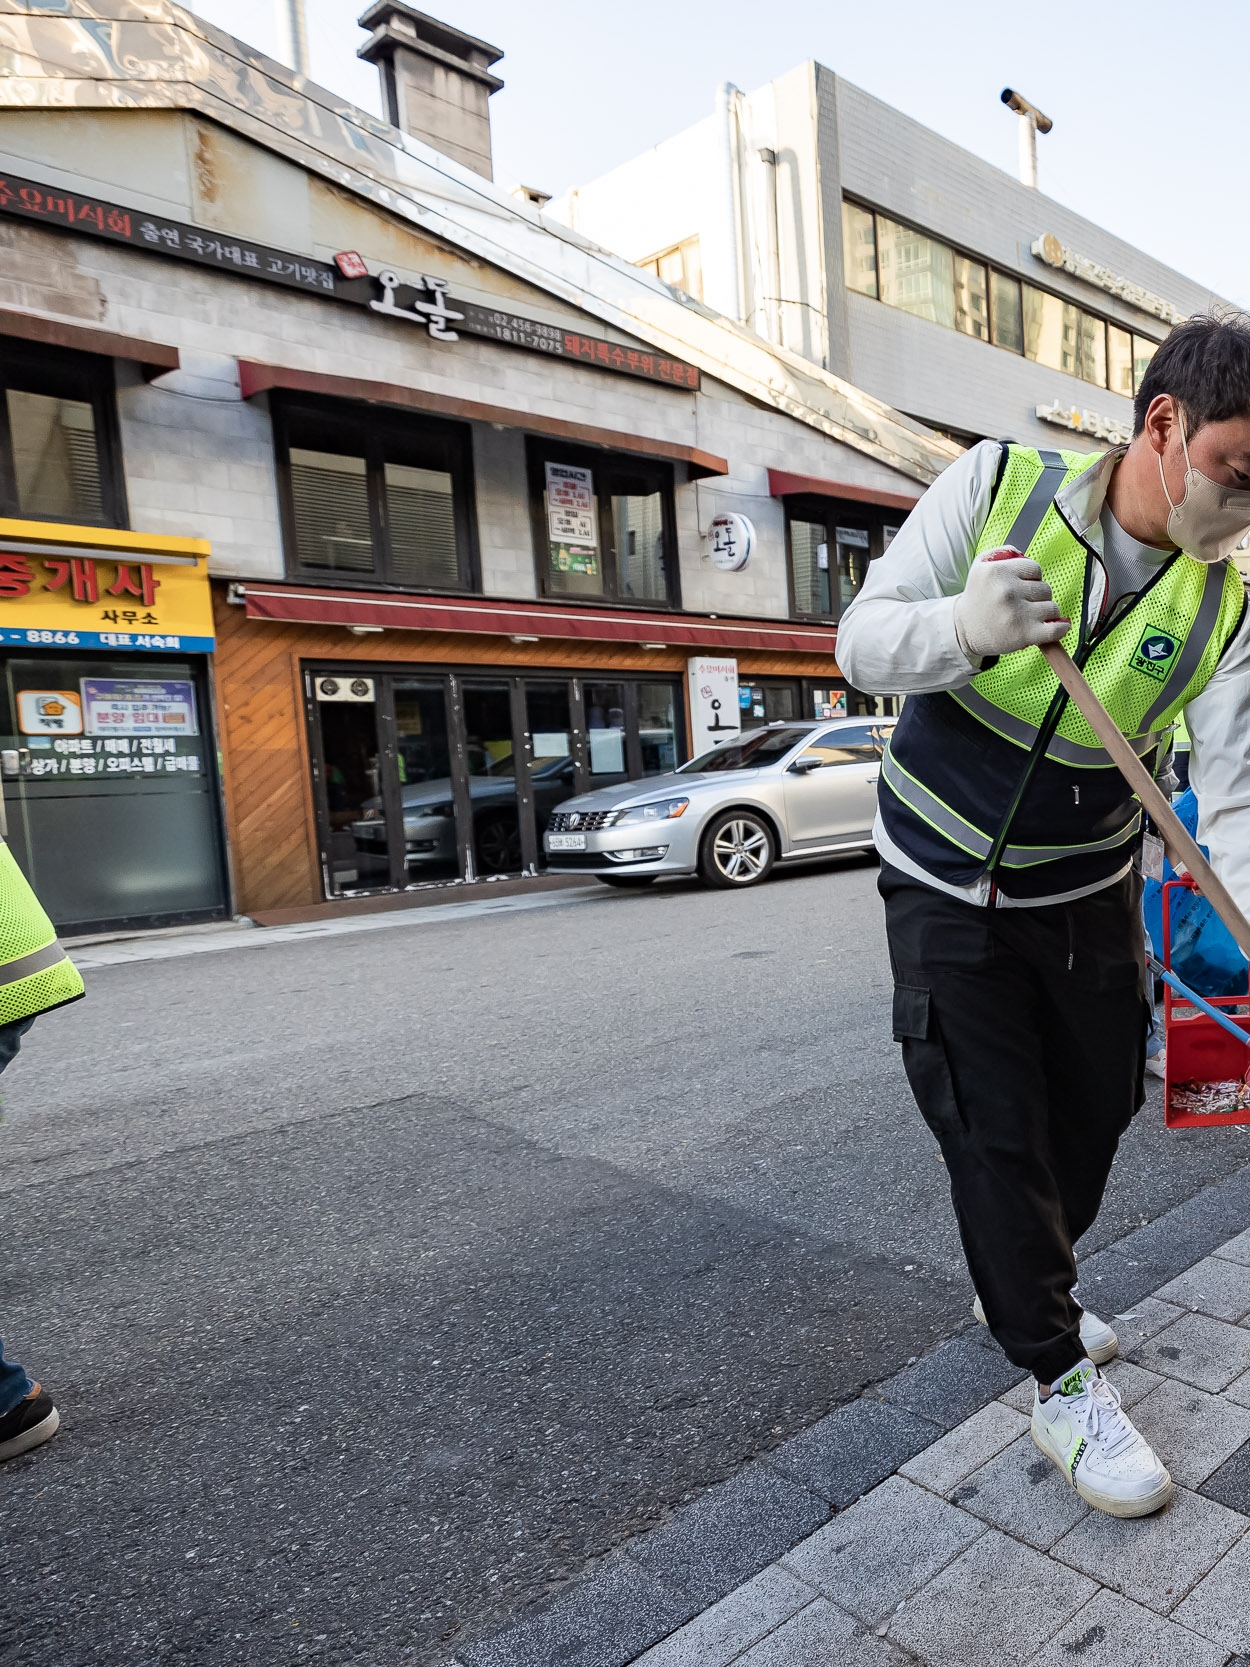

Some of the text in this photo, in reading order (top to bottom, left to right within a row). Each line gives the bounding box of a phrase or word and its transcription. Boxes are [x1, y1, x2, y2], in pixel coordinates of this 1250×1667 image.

[140, 222, 181, 248] 출연
[186, 232, 260, 269] 국가대표
[266, 256, 335, 290] 고기맛집
[369, 269, 464, 341] 오돌
[564, 335, 698, 387] 돼지특수부위 전문점
[100, 609, 159, 625] 사무소
[26, 630, 80, 645] 8866
[99, 633, 132, 646] 대표
[1135, 655, 1165, 676] 광진구
[96, 712, 159, 724] 분양 임대
